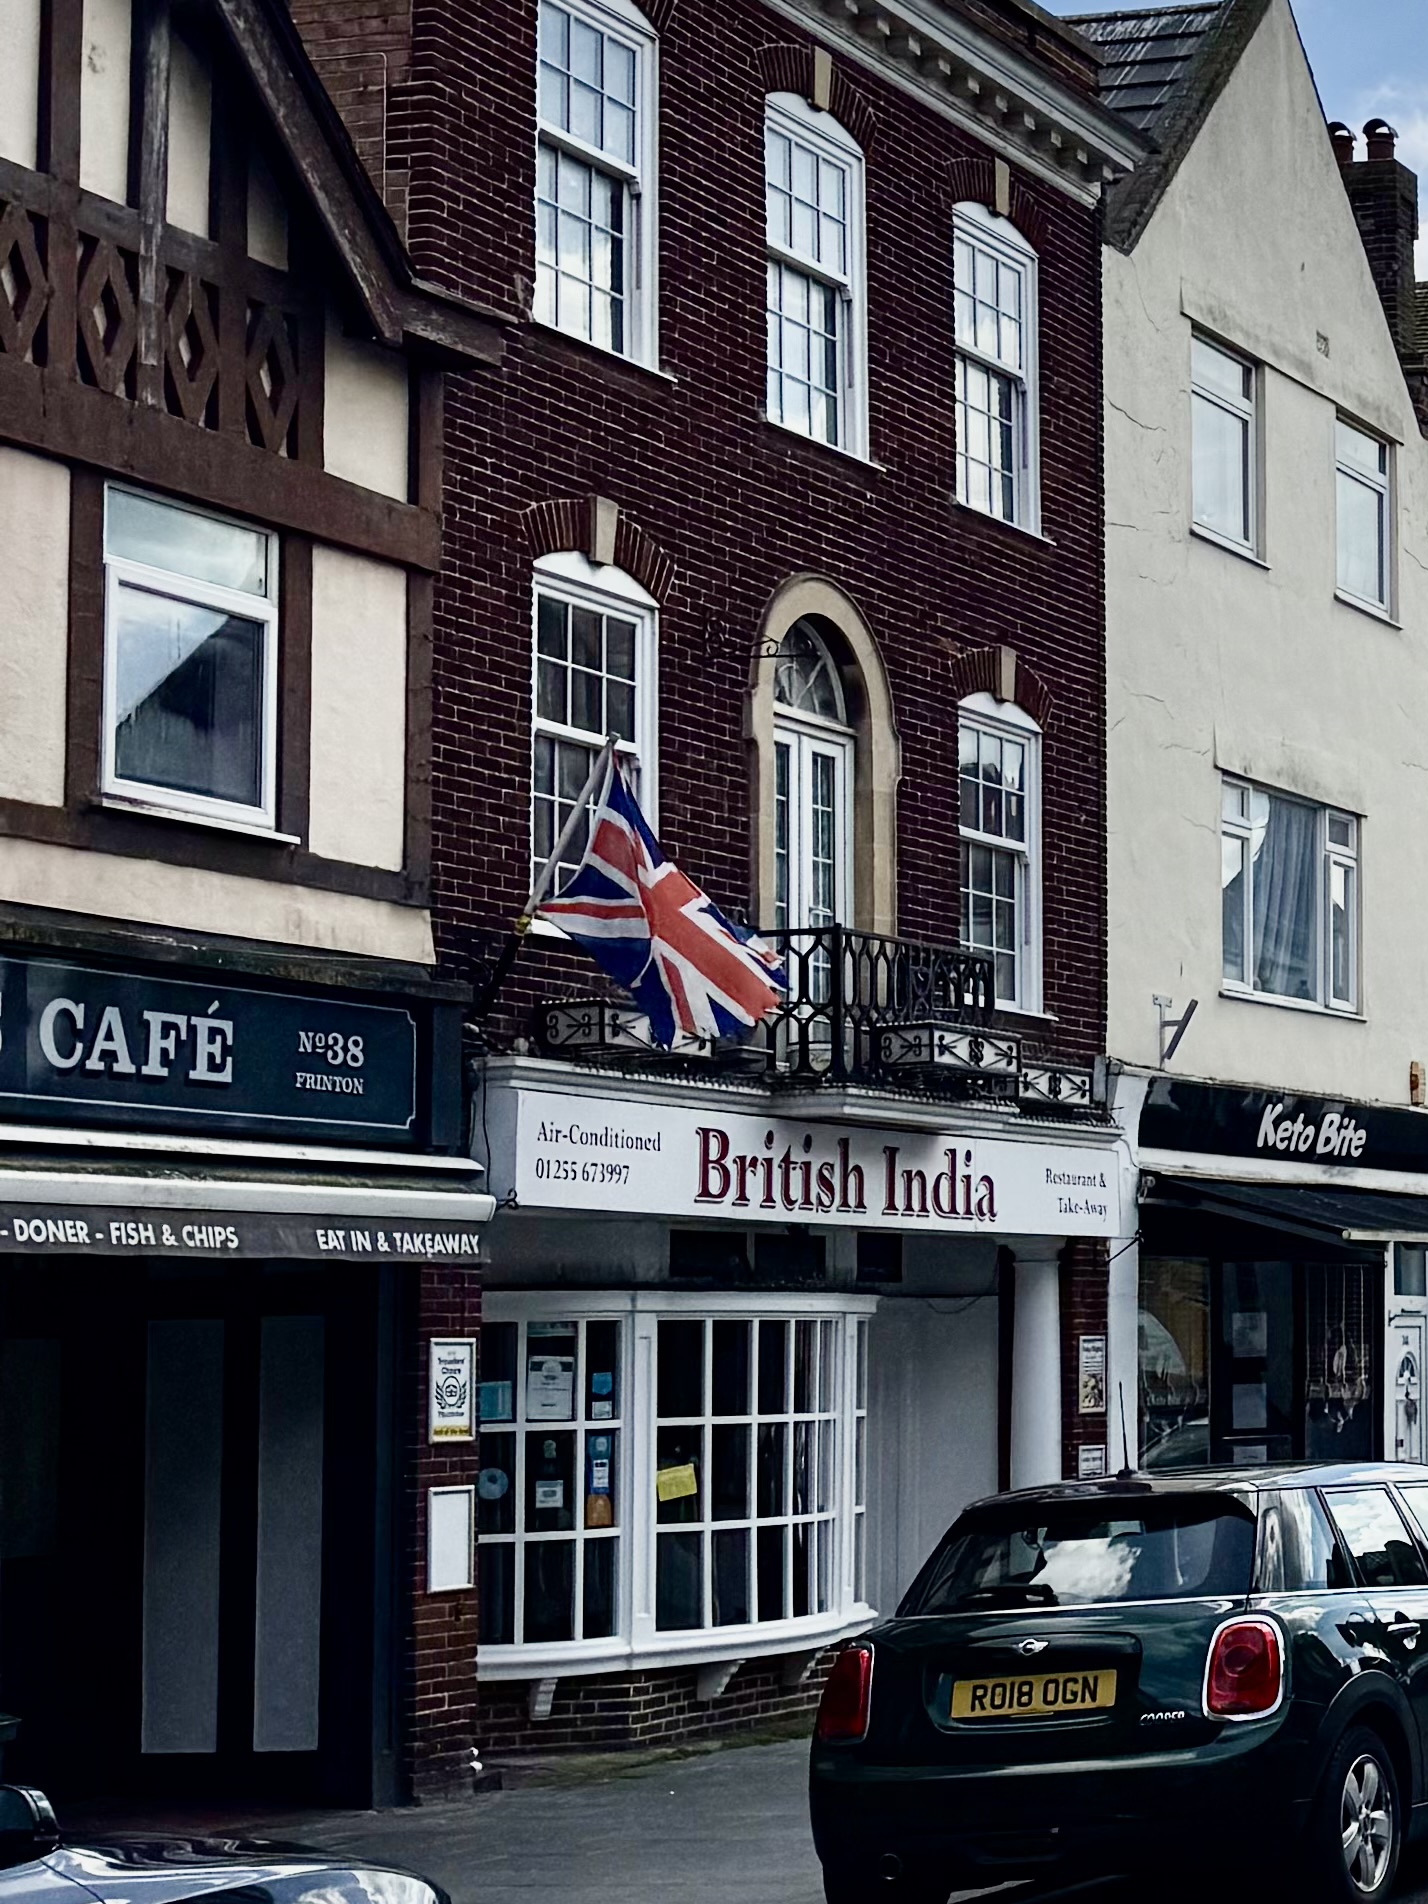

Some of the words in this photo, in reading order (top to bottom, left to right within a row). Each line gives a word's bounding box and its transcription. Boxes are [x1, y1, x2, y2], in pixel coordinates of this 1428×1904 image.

[39, 998, 234, 1083] CAFÉ
[295, 1072, 364, 1095] FRINTON
[537, 1121, 661, 1152] Air-Conditioned
[1257, 1103, 1314, 1152] Keto
[1316, 1112, 1366, 1158] Bite
[536, 1157, 577, 1181] 01255
[582, 1162, 630, 1185] 673997
[694, 1126, 867, 1214] British
[882, 1145, 998, 1222] India
[1045, 1167, 1097, 1188] Restaurant
[1098, 1173, 1107, 1188] &
[1057, 1197, 1108, 1222] Take-Away
[13, 1219, 90, 1244] DONER
[109, 1222, 155, 1246] FISH
[162, 1224, 179, 1247] &
[182, 1225, 239, 1249] CHIPS
[316, 1229, 346, 1251] EAT
[350, 1230, 372, 1252] IN
[377, 1231, 391, 1252] &
[392, 1232, 480, 1255] TAKEAWAY
[970, 1680, 1033, 1712] RO18
[1042, 1675, 1099, 1706] OGN
